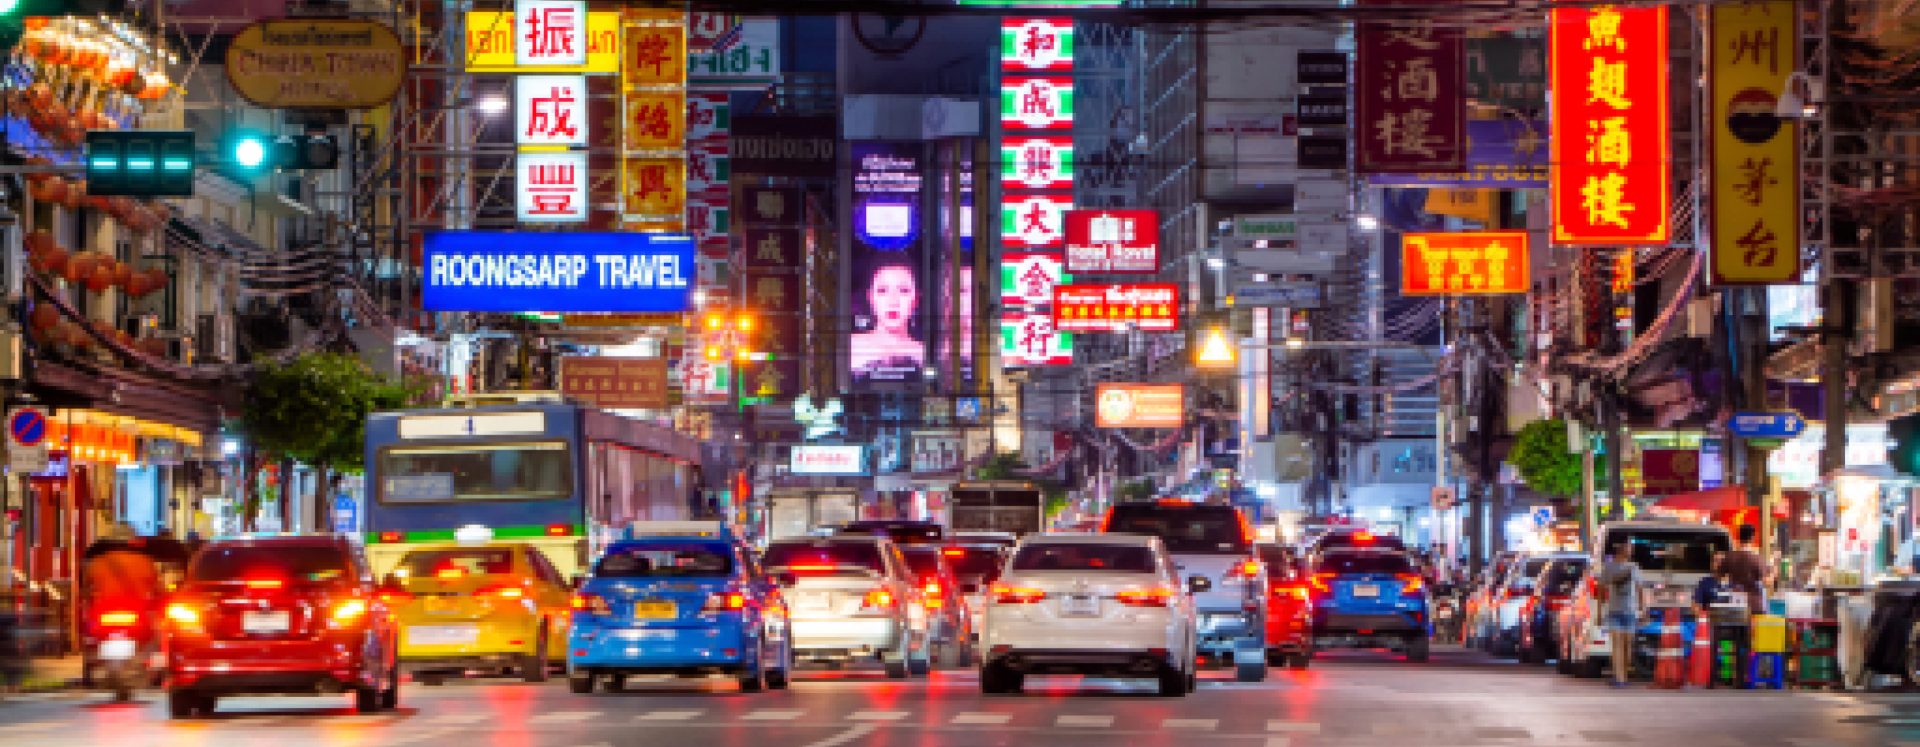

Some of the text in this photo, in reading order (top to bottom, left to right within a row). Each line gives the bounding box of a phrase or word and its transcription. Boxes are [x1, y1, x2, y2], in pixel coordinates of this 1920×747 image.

[524, 8, 578, 215] 振成豐
[430, 253, 687, 289] ROONGSARP TRAVEL
